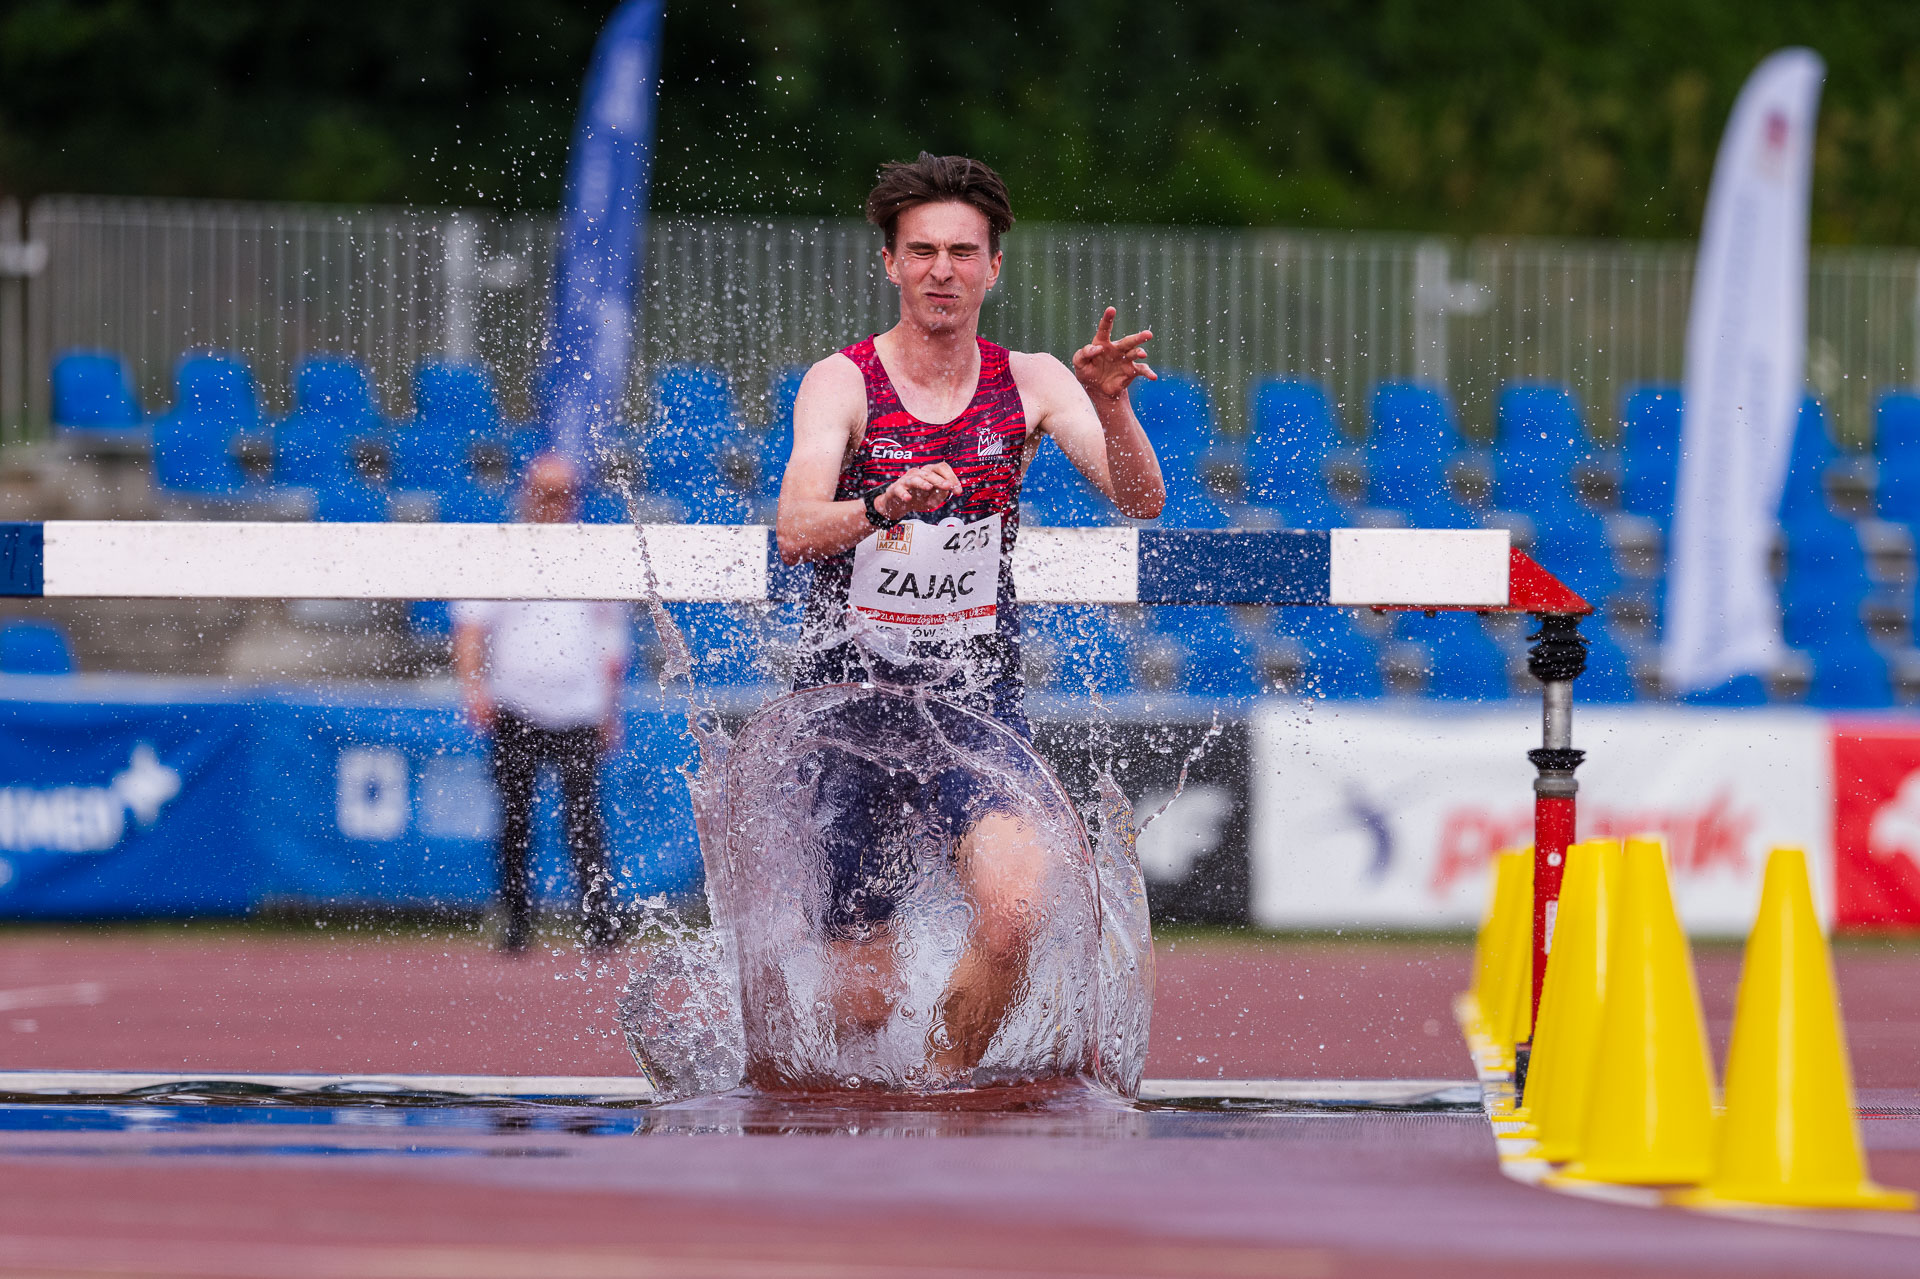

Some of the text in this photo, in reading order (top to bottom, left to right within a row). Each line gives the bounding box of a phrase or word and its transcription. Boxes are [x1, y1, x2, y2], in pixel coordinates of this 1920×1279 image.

[871, 444, 913, 460] Enea
[878, 541, 908, 553] MZLA
[943, 524, 990, 554] 425
[877, 567, 977, 603] ZAJĄC
